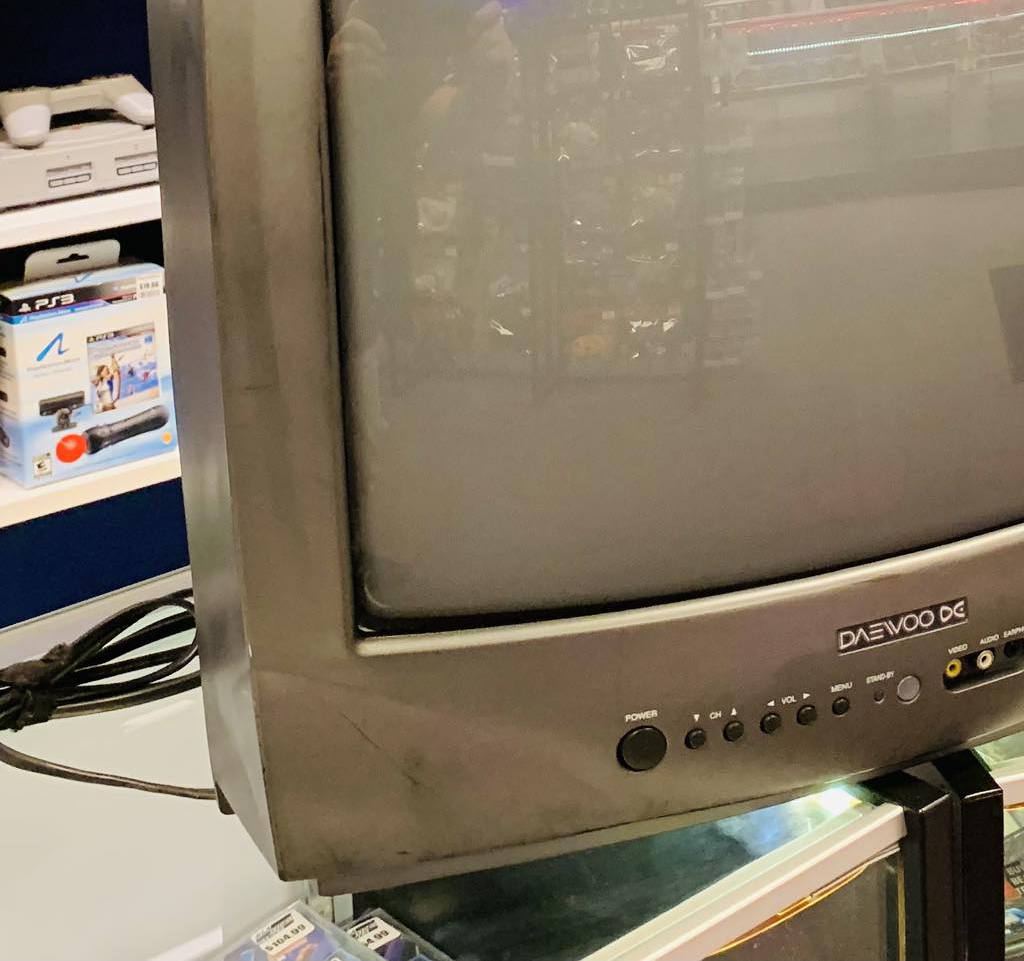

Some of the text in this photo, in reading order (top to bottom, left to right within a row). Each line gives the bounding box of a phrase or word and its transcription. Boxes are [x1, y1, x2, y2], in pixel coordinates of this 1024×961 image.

[35, 293, 75, 311] PS3
[839, 610, 935, 651] DAEWOO
[947, 643, 968, 655] VIDEO
[979, 633, 1000, 646] AUDIO
[866, 670, 895, 685] STAND-BY
[831, 681, 853, 694] MENU
[781, 694, 798, 705] VOL
[625, 709, 658, 723] POWER
[709, 710, 722, 721] CH
[265, 923, 307, 953] $104.99
[363, 929, 390, 947] 4.99
